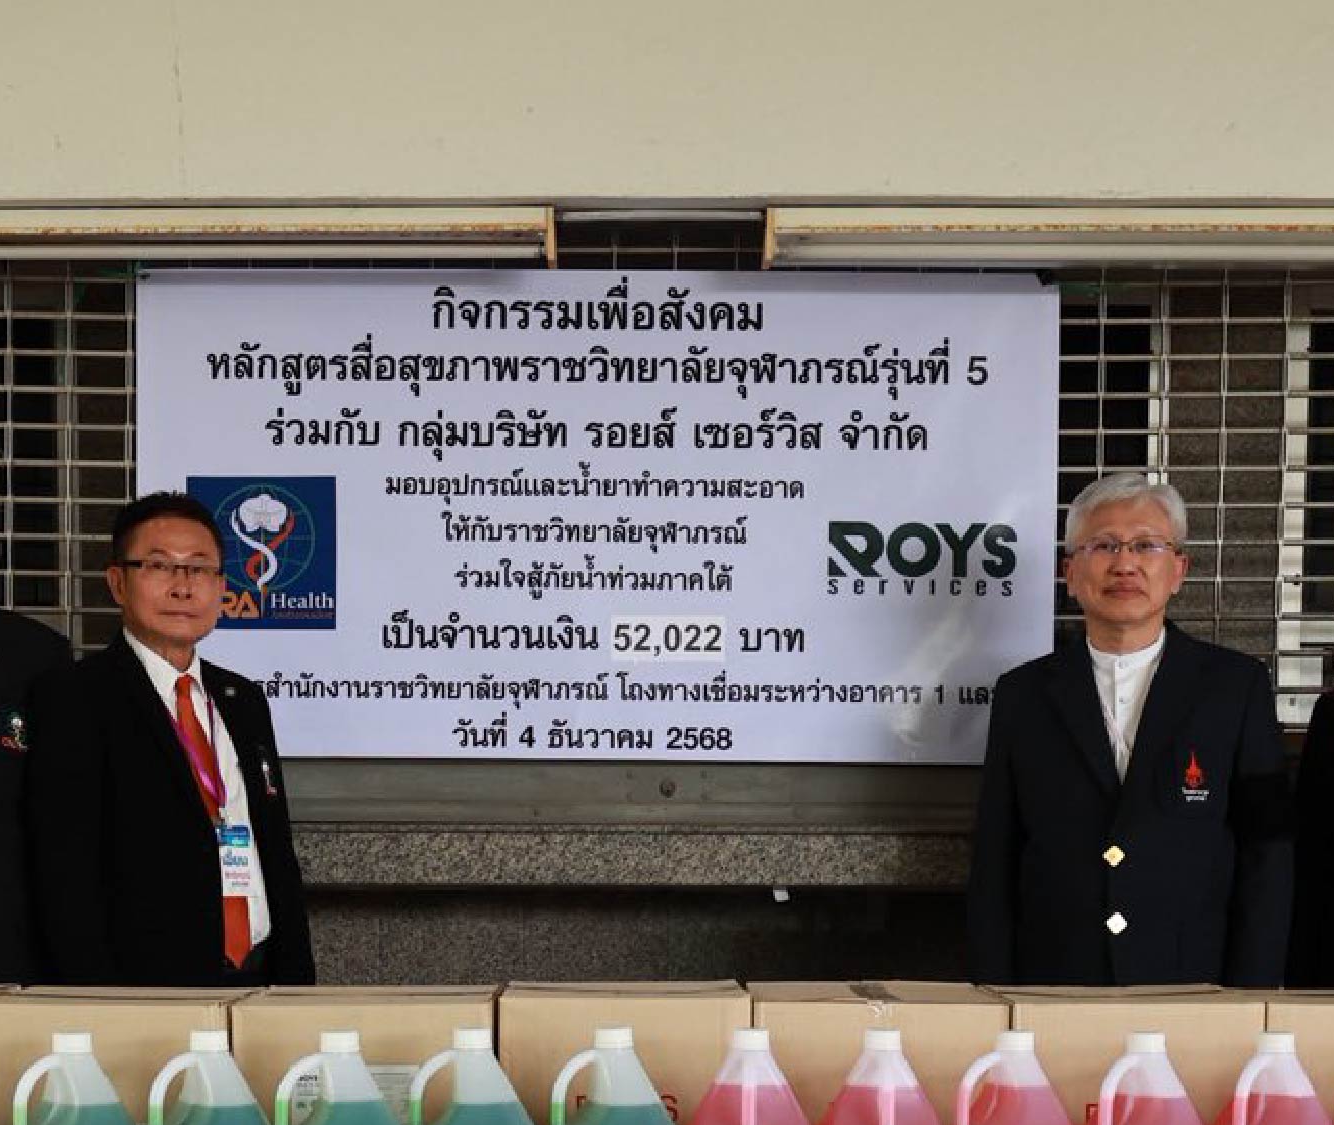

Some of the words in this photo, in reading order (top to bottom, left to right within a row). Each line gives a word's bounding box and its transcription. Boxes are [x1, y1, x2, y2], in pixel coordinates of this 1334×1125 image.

[432, 275, 764, 332] กิจกรรมเพื่อสังคม
[206, 332, 951, 400] หลักสูตรสื่อสุขภาพราชวิทยาลัยจุฬาภรณ์รุ่นที่
[966, 356, 989, 386] 5
[265, 407, 380, 447] ร่วมกับ
[398, 408, 568, 462] กลุ่มบริษัท
[585, 406, 678, 449] รอยส์
[694, 406, 823, 450] เซอร์วิส
[838, 409, 929, 451] จำกัด
[385, 461, 805, 505] มอบอุปกรณ์และน้ำยาทำความสะอาด
[440, 510, 748, 553] ให้กับราชวิทยาลัยจุฬาภรณ์
[827, 521, 1018, 579] ROYS
[454, 553, 733, 600] ร่วมใจสู้ภัยน้ำท่วมภาคใต้
[826, 578, 1014, 597] services
[270, 591, 334, 609] Health
[382, 609, 598, 650] เป็นจำนวนเงิน
[613, 624, 722, 656] 52,022
[740, 626, 805, 653] บาท
[617, 670, 923, 704] โถงทางเชื่อมระหว่างอาคาร
[933, 684, 944, 704] 1
[451, 712, 508, 749] วันที่
[518, 724, 535, 748] 4
[547, 719, 654, 749] ธันวาคม
[666, 726, 733, 750] 2568
